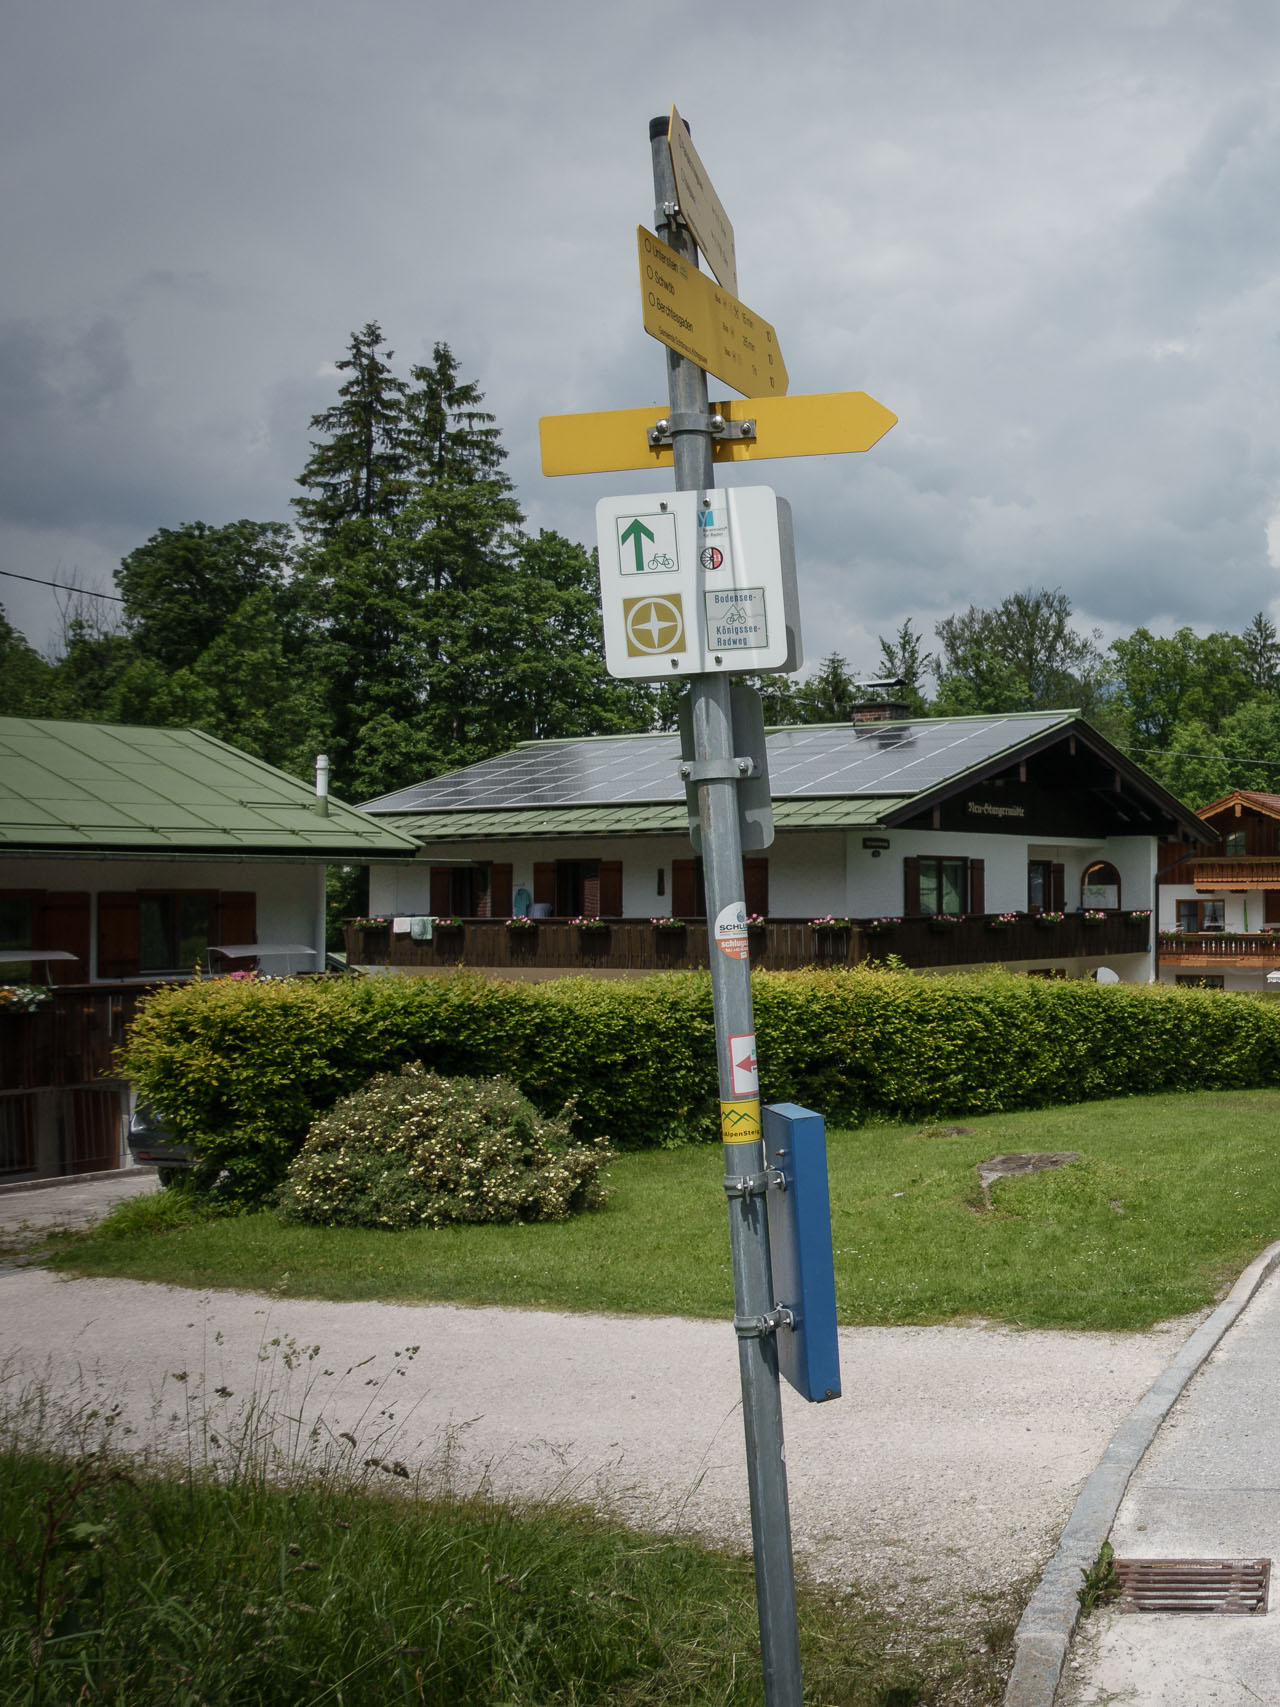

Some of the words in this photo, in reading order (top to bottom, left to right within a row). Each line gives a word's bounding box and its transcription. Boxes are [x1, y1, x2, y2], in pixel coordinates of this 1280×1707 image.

[714, 593, 757, 604] Bodensee-
[716, 625, 761, 635] Königssee-
[717, 637, 748, 647] Radweg
